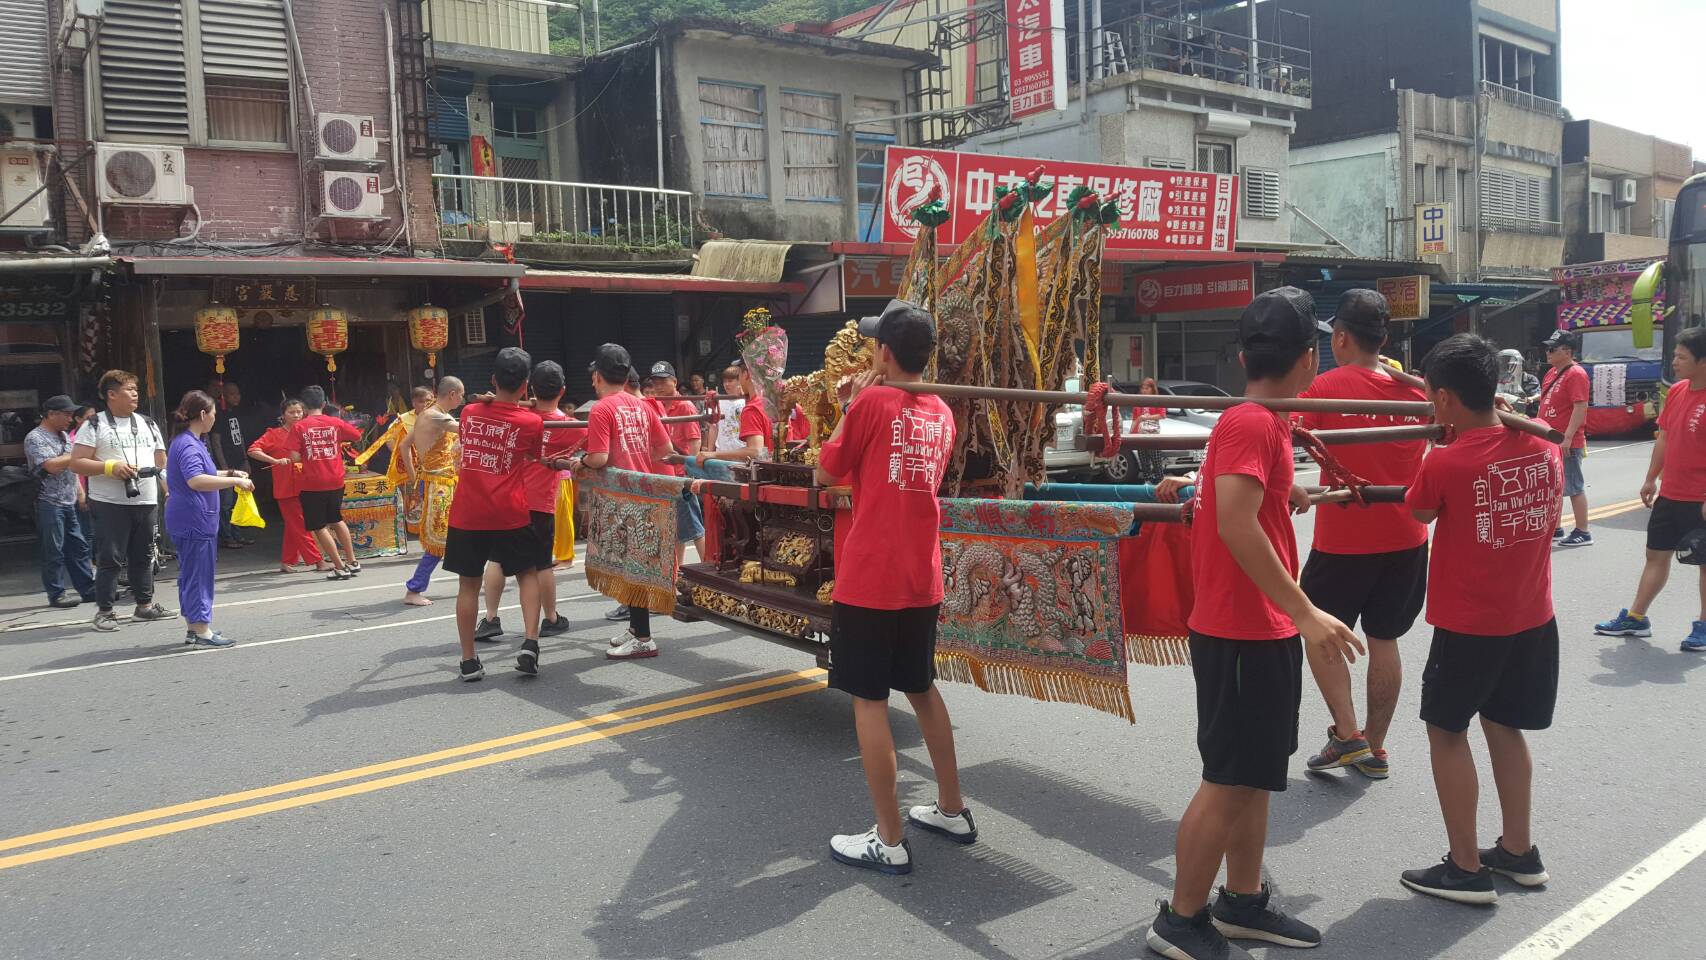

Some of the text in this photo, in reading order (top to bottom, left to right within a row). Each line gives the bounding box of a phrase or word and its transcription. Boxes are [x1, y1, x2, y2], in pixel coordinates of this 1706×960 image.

[1014, 79, 1050, 96] 0937160788
[1214, 177, 1230, 248] 巨力機油
[1423, 207, 1443, 242] 中山
[1382, 280, 1417, 302] 民宿
[888, 416, 903, 484] 宜蘭
[344, 480, 388, 496] 恭迎
[1472, 475, 1492, 543] 宜蘭
